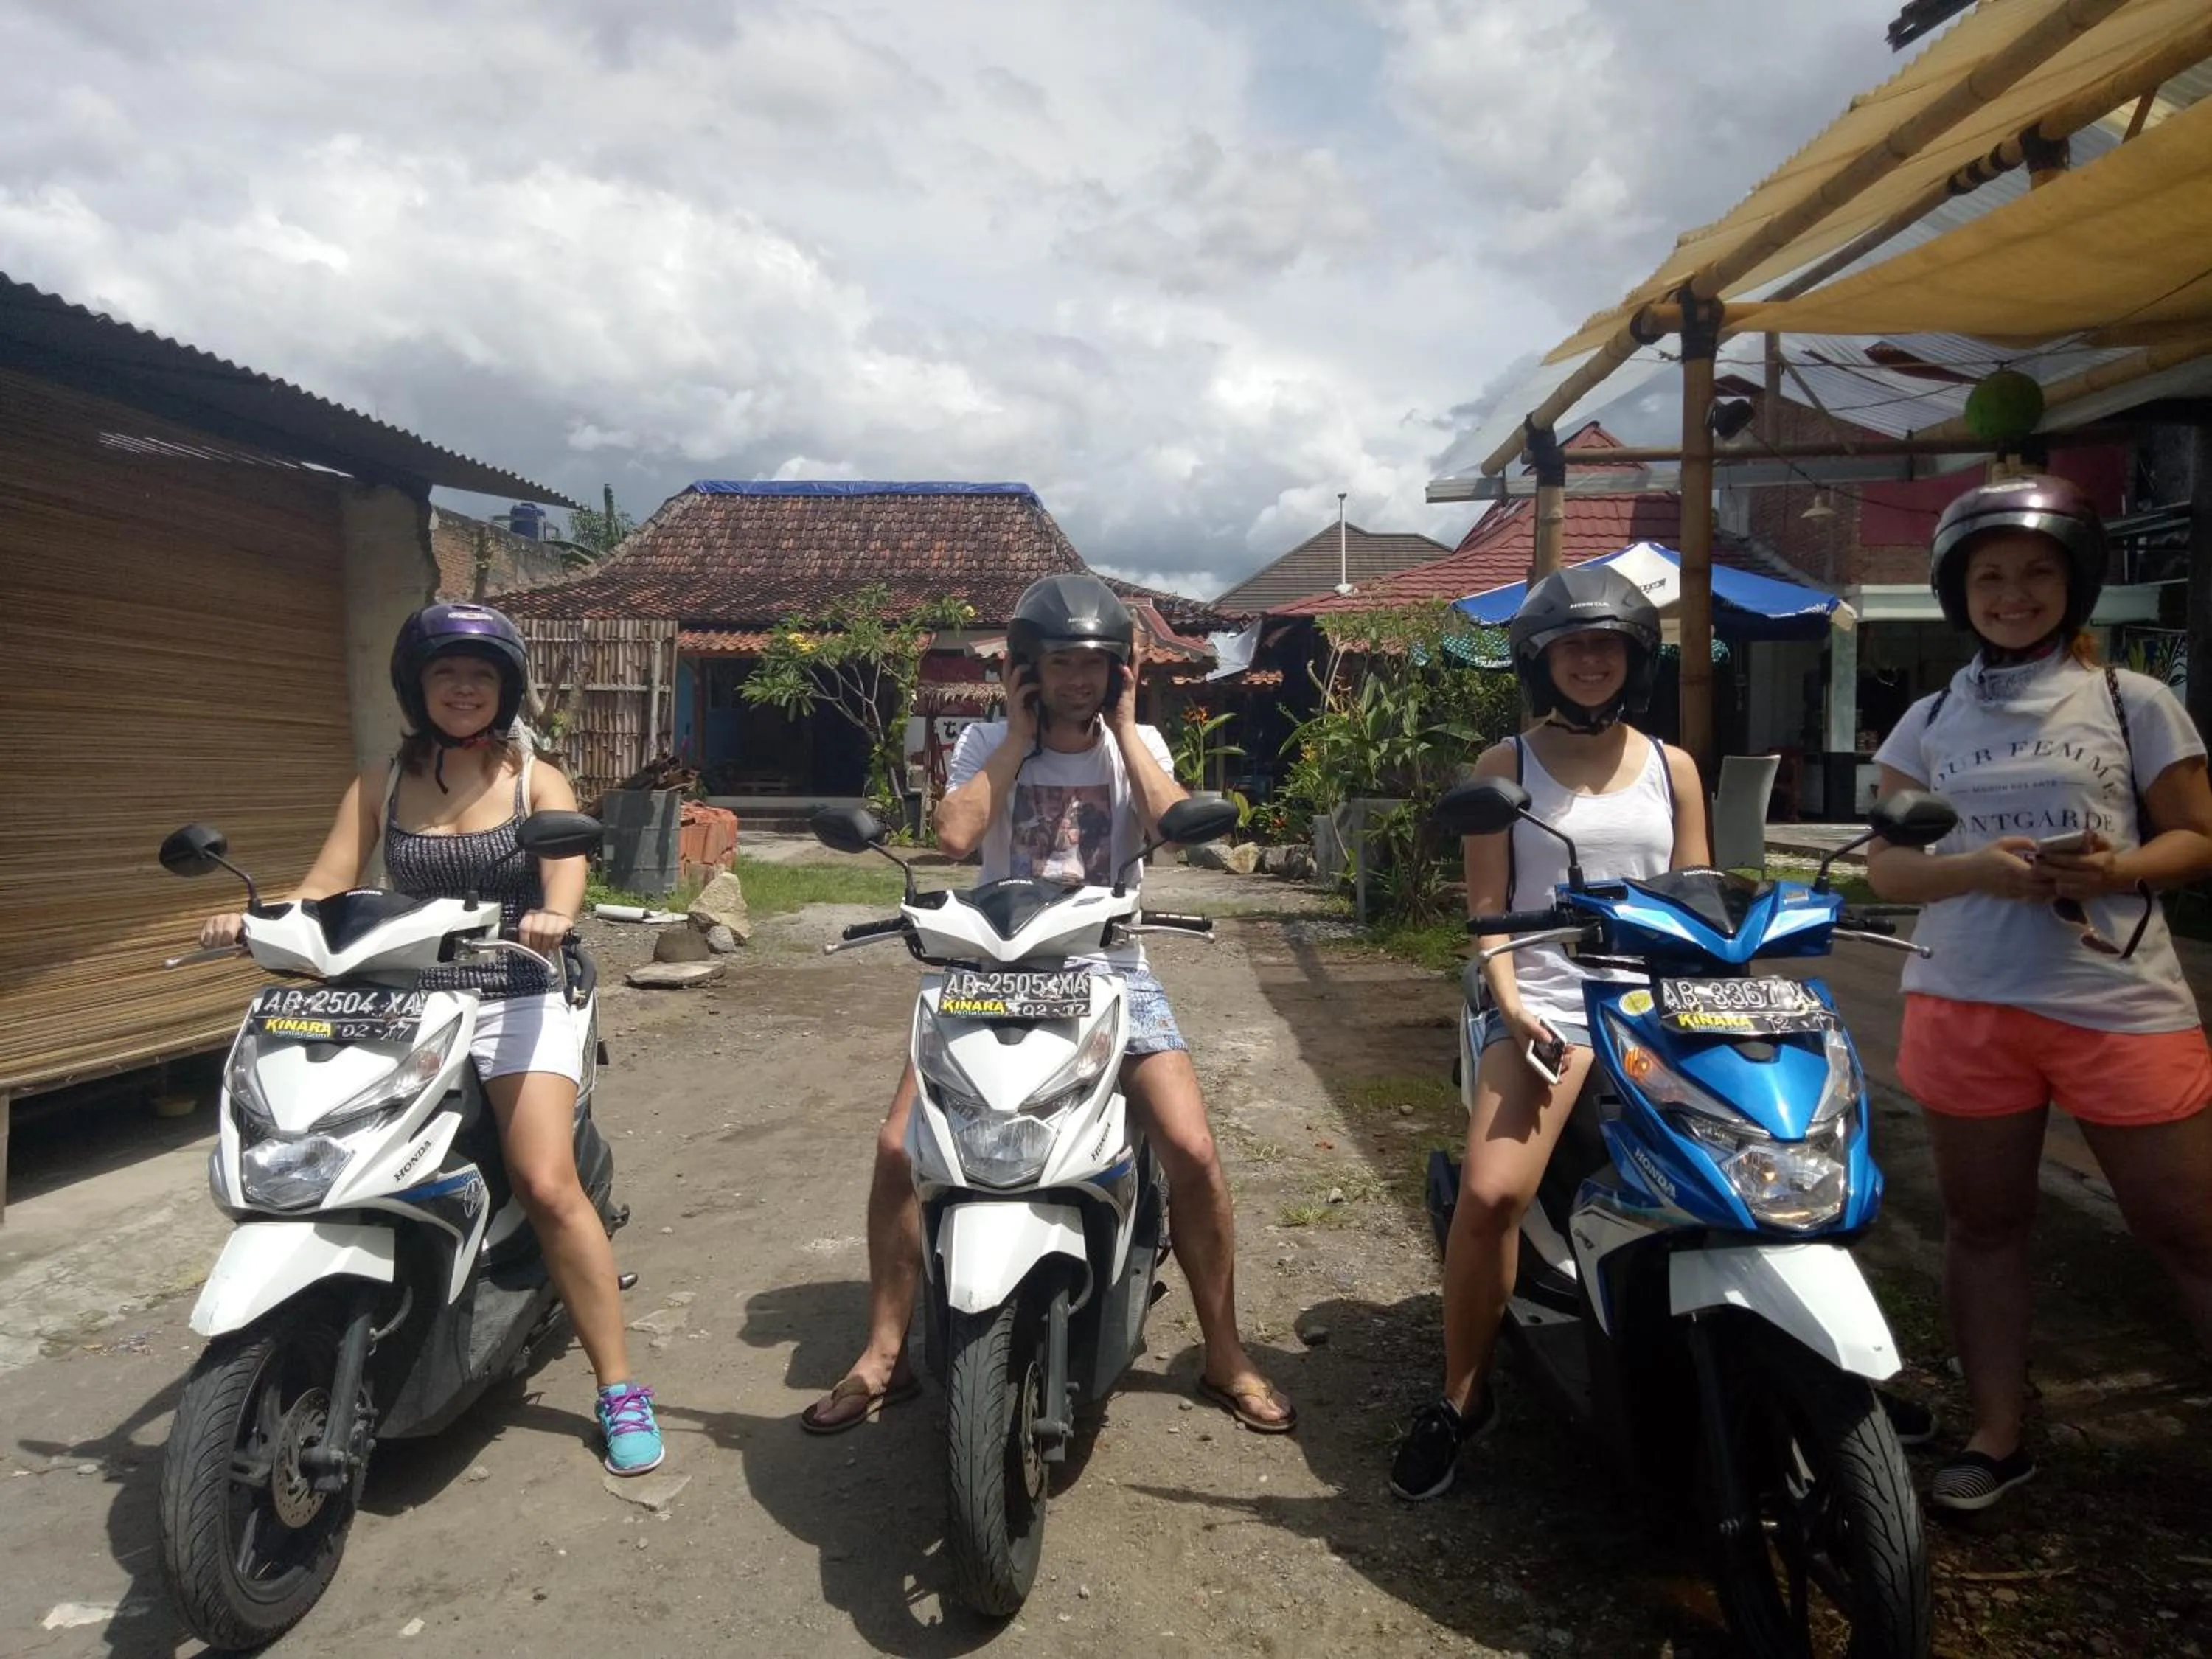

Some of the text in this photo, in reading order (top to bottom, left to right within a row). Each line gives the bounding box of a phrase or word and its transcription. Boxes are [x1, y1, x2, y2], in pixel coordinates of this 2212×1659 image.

[2009, 740, 2118, 800] FEMME
[946, 973, 978, 996] AB
[989, 973, 1045, 994] 2505
[1662, 981, 1697, 1009] AB
[264, 990, 302, 1014] AB
[310, 990, 378, 1014] 2504
[943, 999, 1004, 1015] KINARA
[265, 1018, 331, 1035] KINARA
[1678, 1014, 1754, 1030] KINARA
[393, 1140, 431, 1182] HONDA
[1635, 1147, 1676, 1200] HONDA
